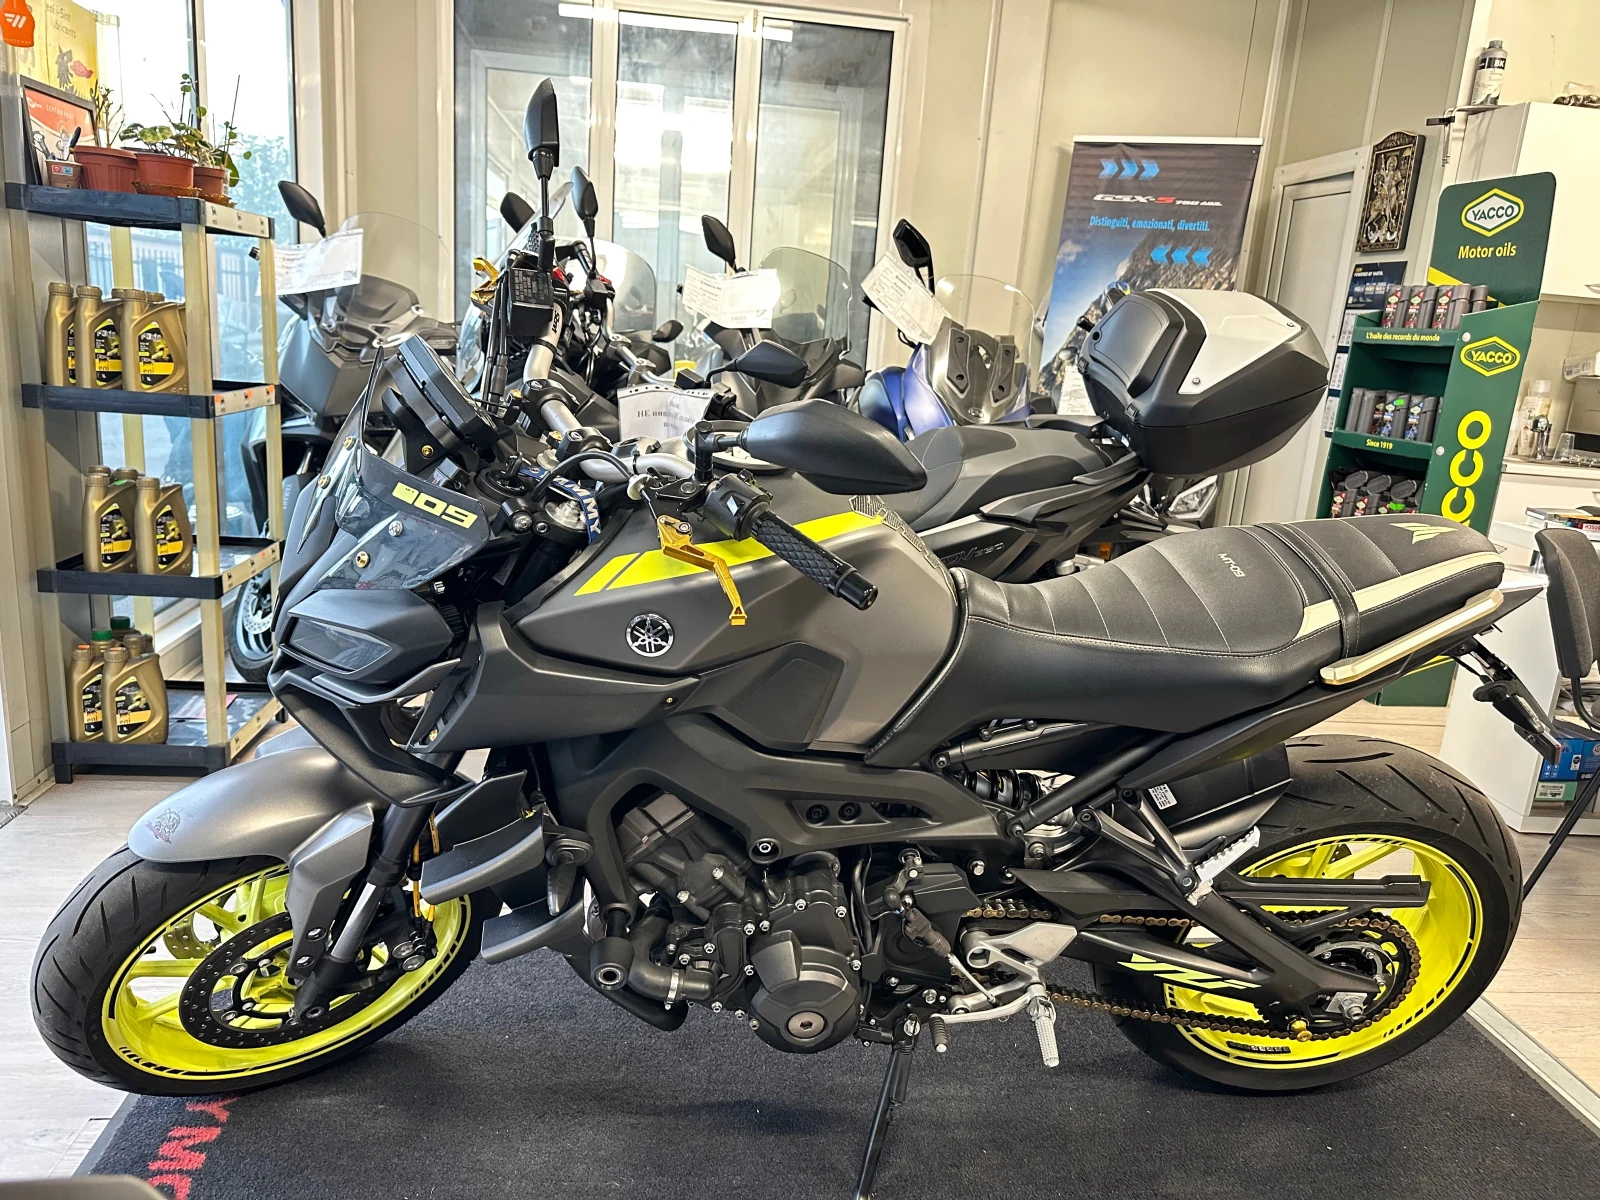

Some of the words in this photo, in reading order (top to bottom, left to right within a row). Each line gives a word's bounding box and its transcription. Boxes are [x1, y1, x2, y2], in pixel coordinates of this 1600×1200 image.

[1471, 204, 1515, 221] YACCO
[1089, 215, 1130, 230] Distinguiti,
[1131, 219, 1175, 232] emozionati,
[1177, 220, 1210, 232] divertiti.
[1458, 245, 1494, 260] Motor
[1495, 242, 1517, 258] oils
[1366, 332, 1383, 340] L'huile
[1383, 332, 1392, 340] des
[1392, 332, 1412, 341] records
[1412, 333, 1420, 341] du
[1420, 333, 1440, 342] monde
[1470, 350, 1512, 365] YACCO
[1366, 438, 1378, 449] Since
[1379, 440, 1393, 450] 1919
[1441, 410, 1492, 527] CCO
[1218, 552, 1246, 578] MT-09
